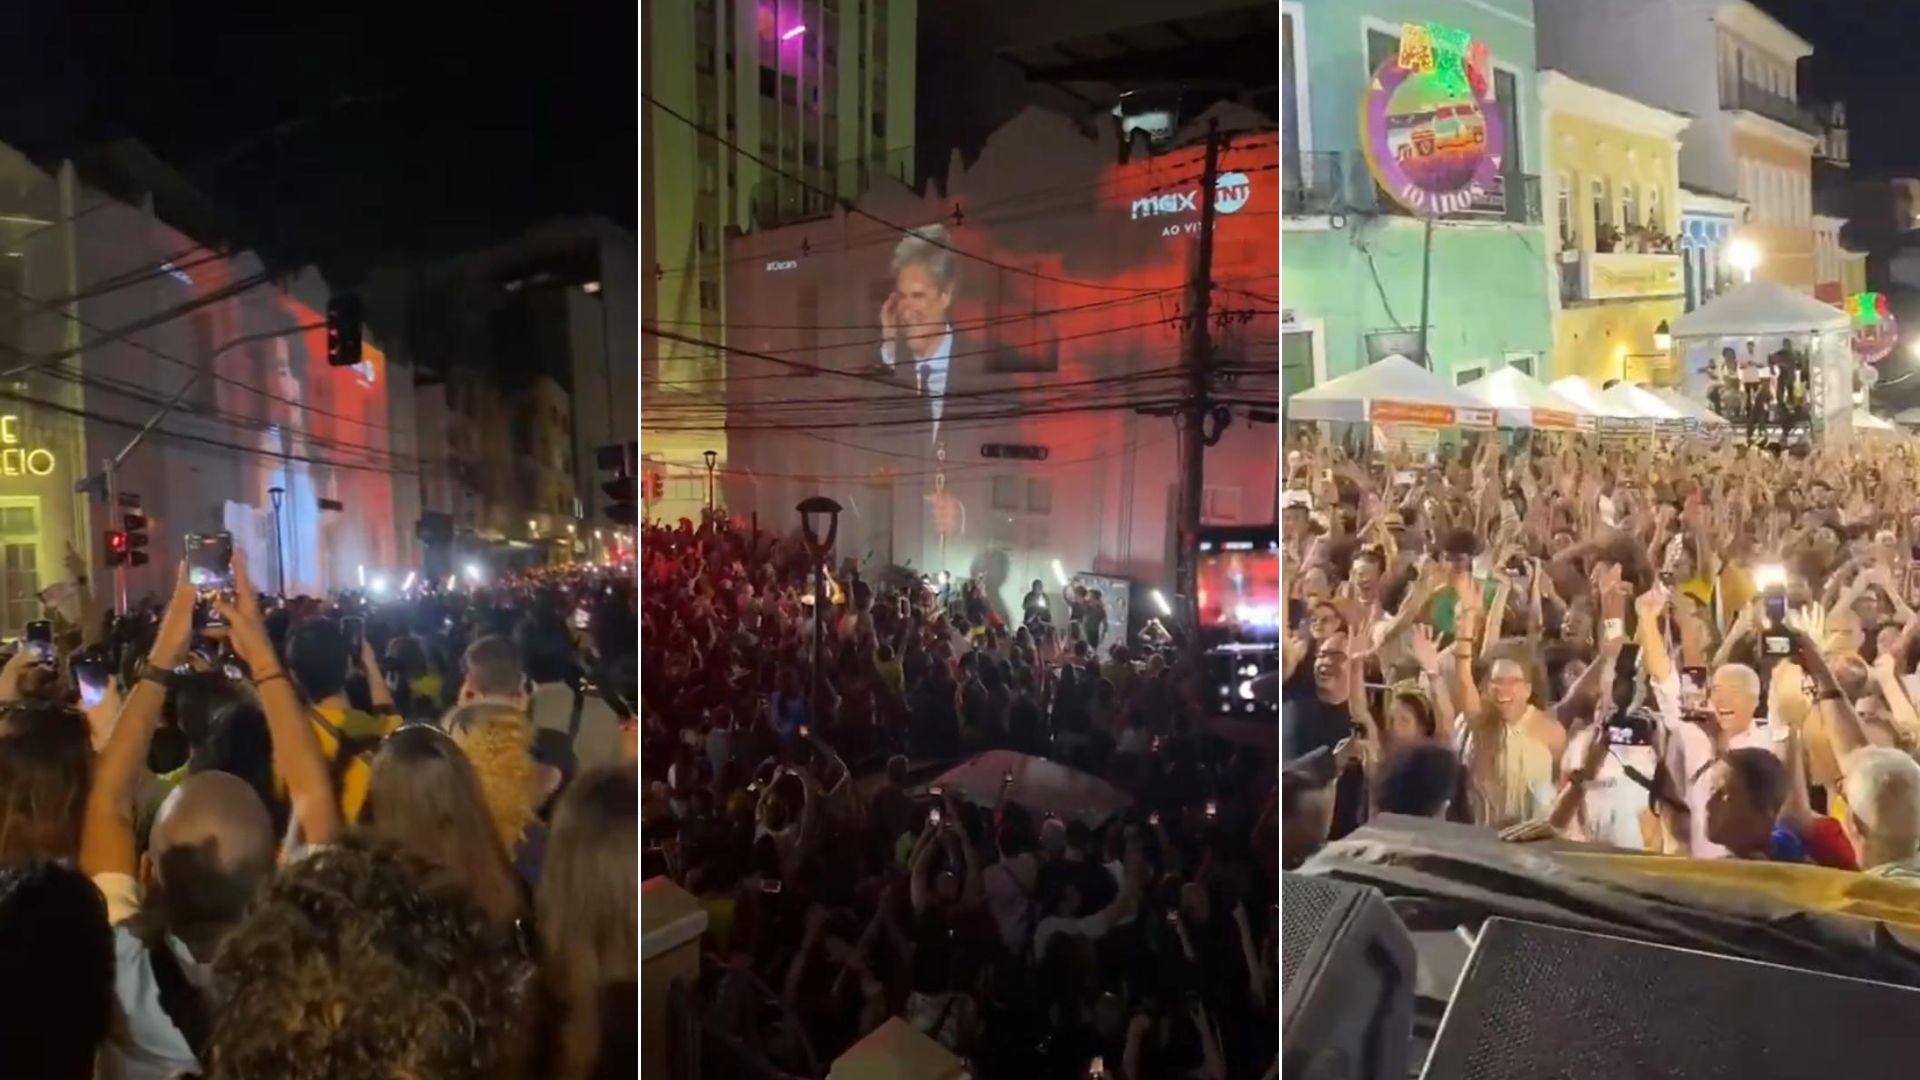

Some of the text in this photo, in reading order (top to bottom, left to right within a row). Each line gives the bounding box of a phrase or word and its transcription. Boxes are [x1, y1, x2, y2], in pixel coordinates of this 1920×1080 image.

[1131, 190, 1198, 219] max
[1162, 225, 1180, 236] AO
[0, 447, 56, 477] EIO
